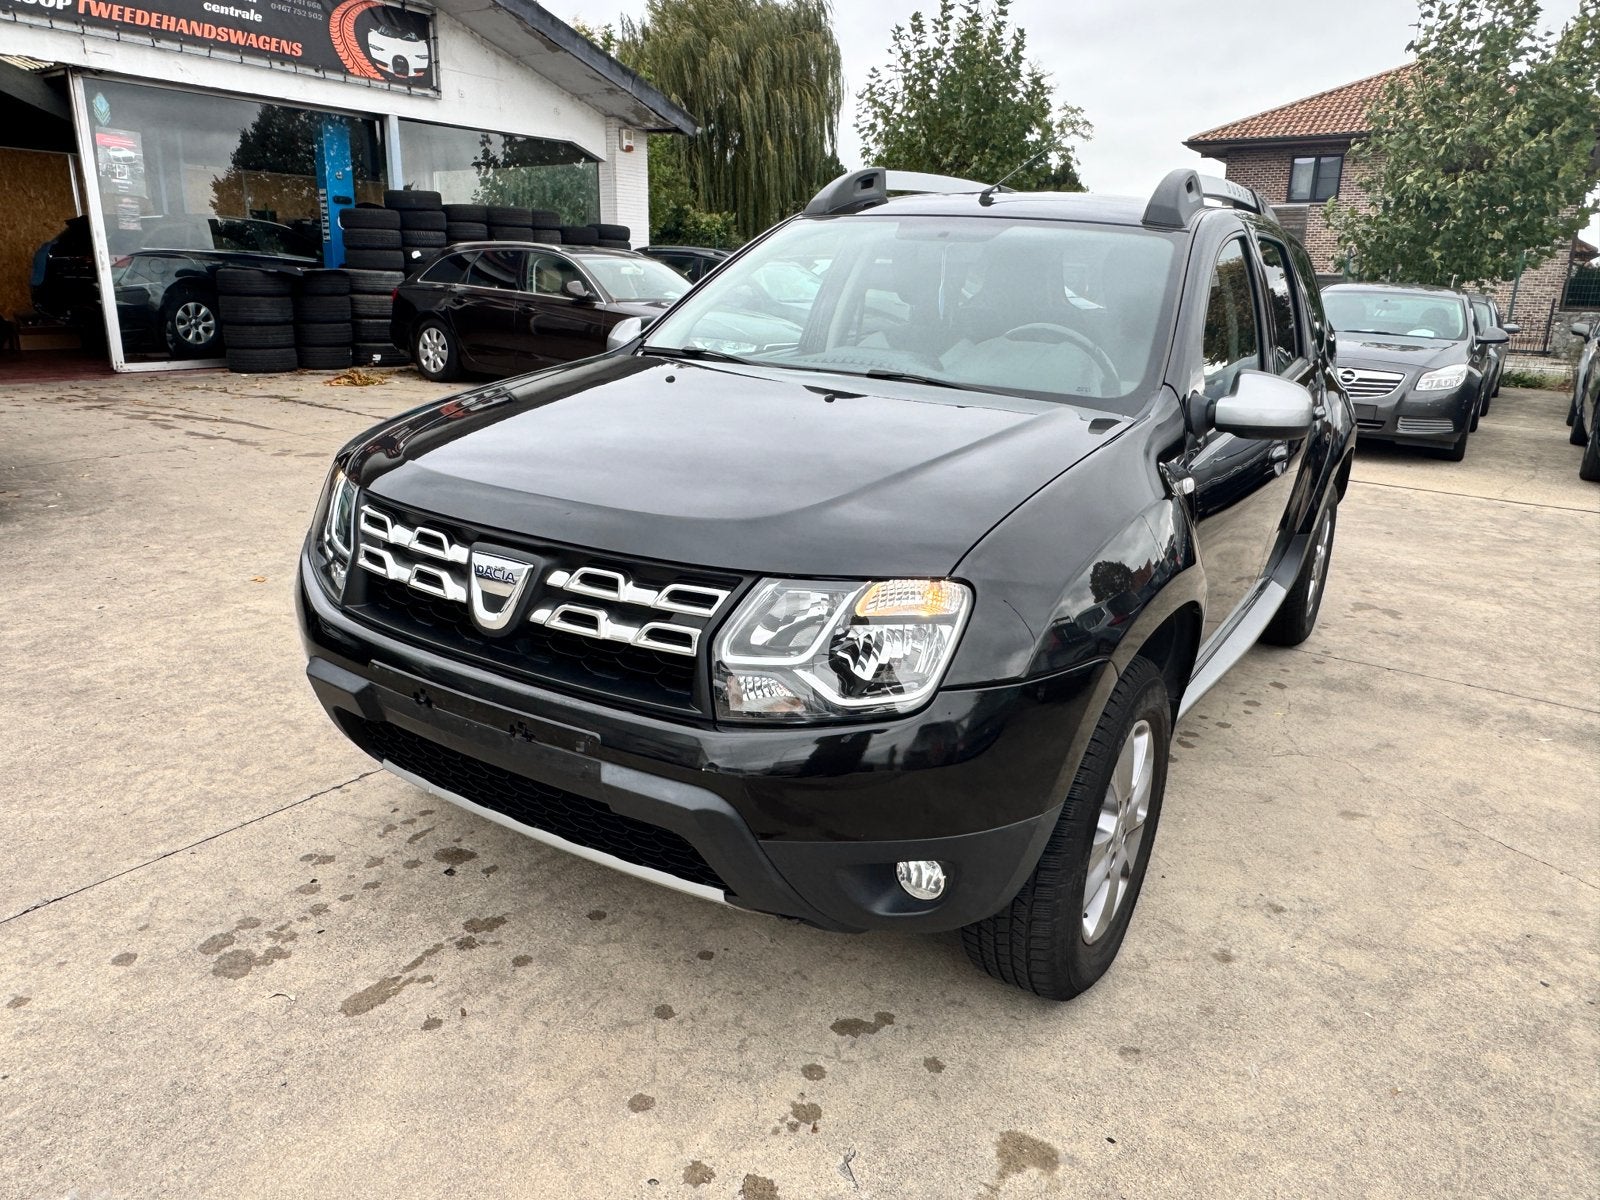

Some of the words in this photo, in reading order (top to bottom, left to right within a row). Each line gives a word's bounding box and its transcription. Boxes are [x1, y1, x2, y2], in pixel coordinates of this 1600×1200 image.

[203, 2, 262, 22] centrale
[62, 0, 303, 57] TWEEDEHANDSWAGENS
[475, 564, 515, 583] DACIA
